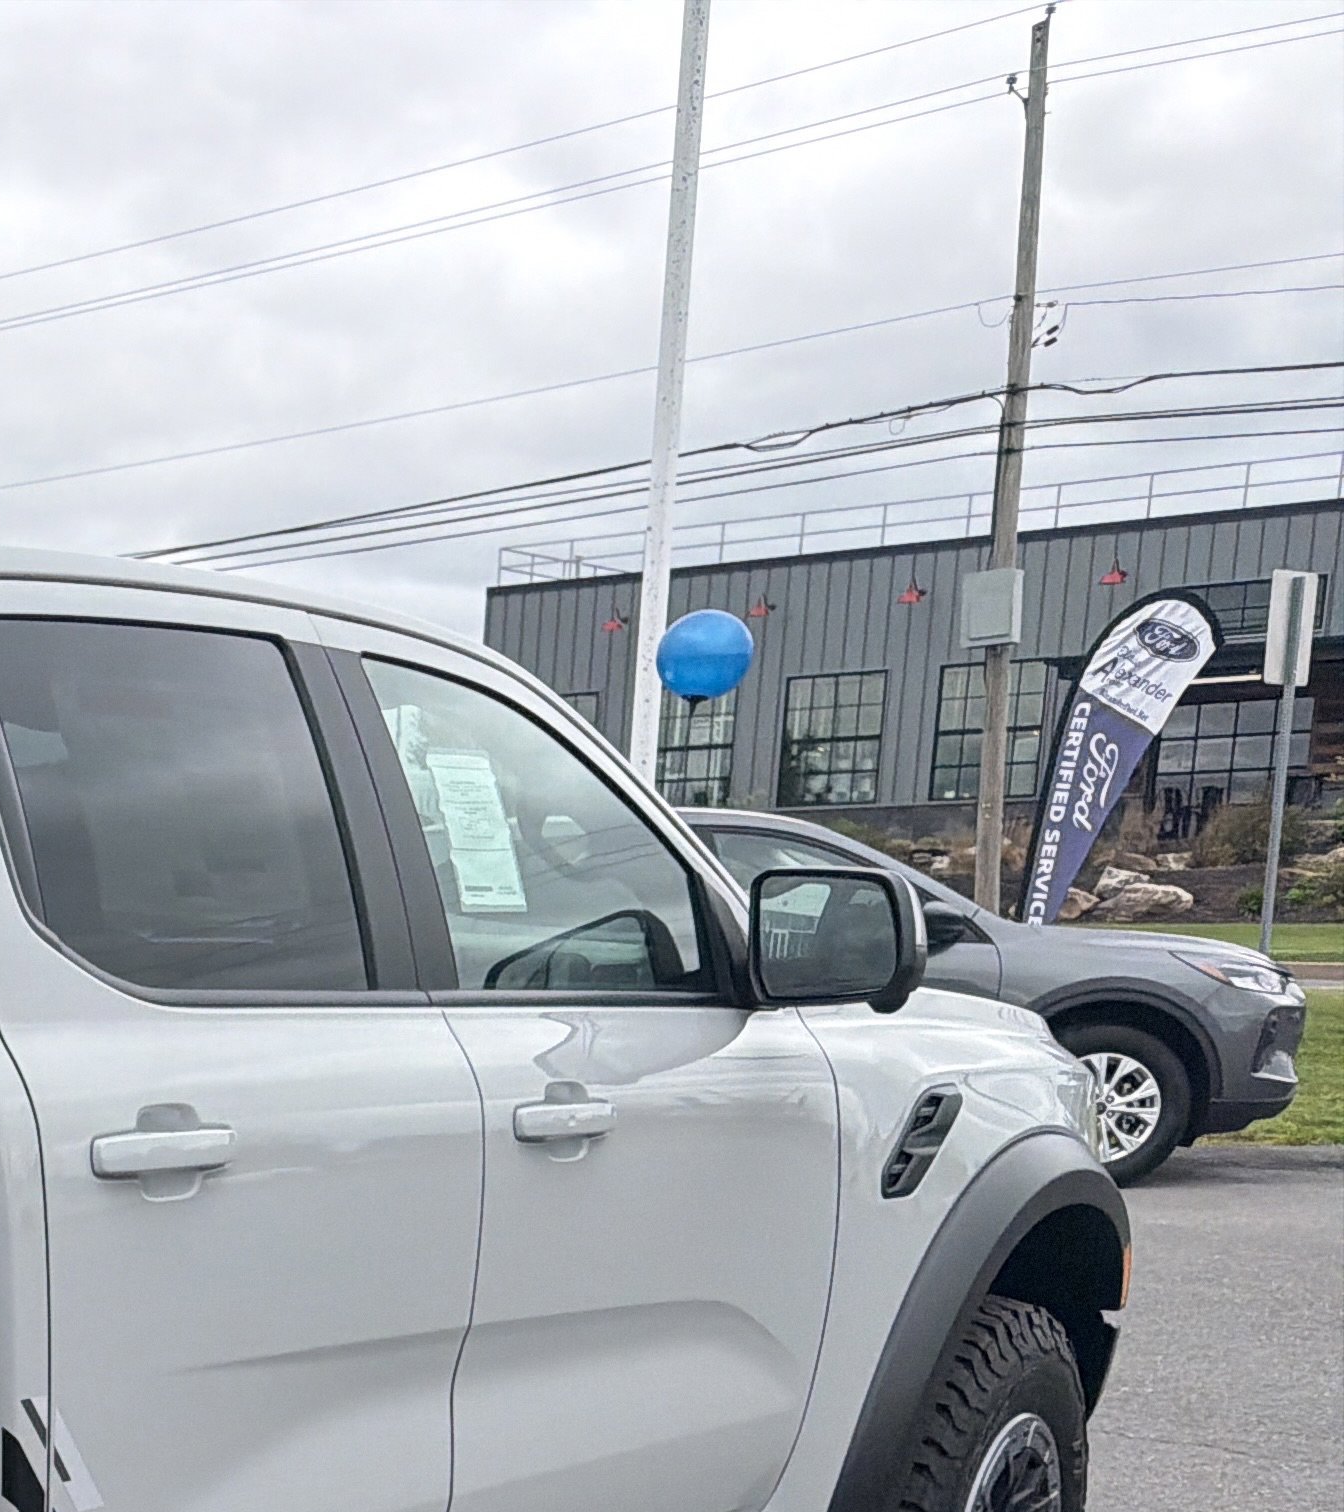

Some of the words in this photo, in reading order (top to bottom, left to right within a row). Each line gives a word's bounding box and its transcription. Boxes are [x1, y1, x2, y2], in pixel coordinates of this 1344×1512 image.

[1091, 656, 1174, 704] Alexander
[1049, 701, 1092, 823] CERTIFIED
[1072, 732, 1119, 832] Ford
[1027, 829, 1061, 926] SERVICE
